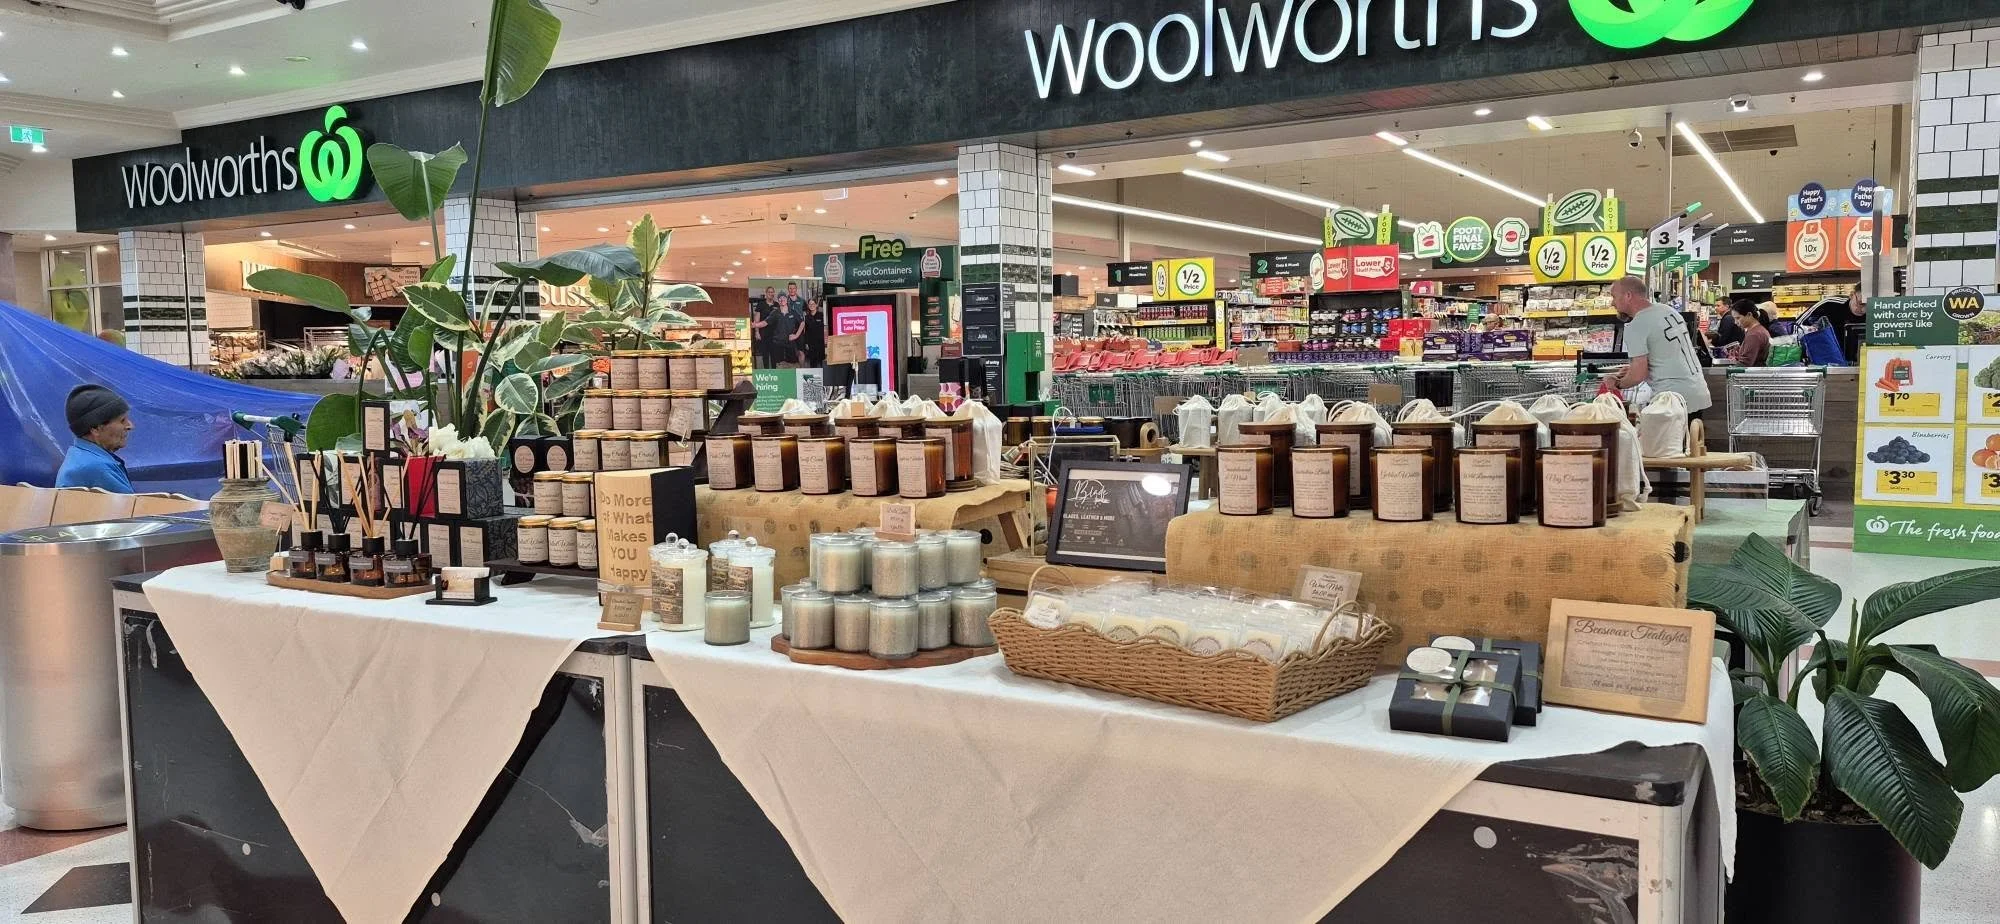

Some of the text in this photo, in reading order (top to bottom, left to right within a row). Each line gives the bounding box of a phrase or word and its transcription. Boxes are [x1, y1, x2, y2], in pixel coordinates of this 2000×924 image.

[121, 135, 298, 209] Woolworths
[1800, 197, 1824, 205] Father's
[1803, 190, 1821, 201] Happy
[1453, 226, 1484, 235] FOOTY
[1453, 234, 1483, 243] FINAL
[1658, 231, 1670, 245] 3
[861, 237, 903, 260] Free
[1452, 243, 1483, 251] FAVES
[1677, 240, 1685, 252] 2
[1804, 244, 1817, 253] 10x
[1857, 241, 1871, 251] 10x
[1544, 247, 1561, 264] 1/2
[1590, 244, 1610, 261] 1/2
[1695, 246, 1701, 258] 1
[853, 268, 872, 277] Food
[873, 266, 913, 276] Containers
[1257, 259, 1268, 274] 2
[1115, 269, 1122, 283] 1
[1182, 269, 1200, 283] 1/2
[1951, 287, 1978, 296] PROUDLY
[1874, 300, 1937, 311] Hand picked
[1948, 297, 1979, 309] WA
[1874, 310, 1895, 319] with
[1920, 310, 1934, 320] by
[1951, 312, 1975, 320] GROWN
[843, 319, 865, 327] Everyday
[1873, 319, 1933, 331] growers like
[1873, 329, 1906, 338] Lam Ti
[755, 373, 779, 382] We're
[756, 383, 779, 393] hiring
[1911, 431, 1951, 440] Blueberries
[614, 493, 652, 507] More
[612, 511, 654, 525] What
[1890, 519, 1924, 536] The
[1927, 523, 1967, 541] fresh
[610, 545, 637, 561] YOU
[1574, 619, 1690, 647] Beeswax Tealights
